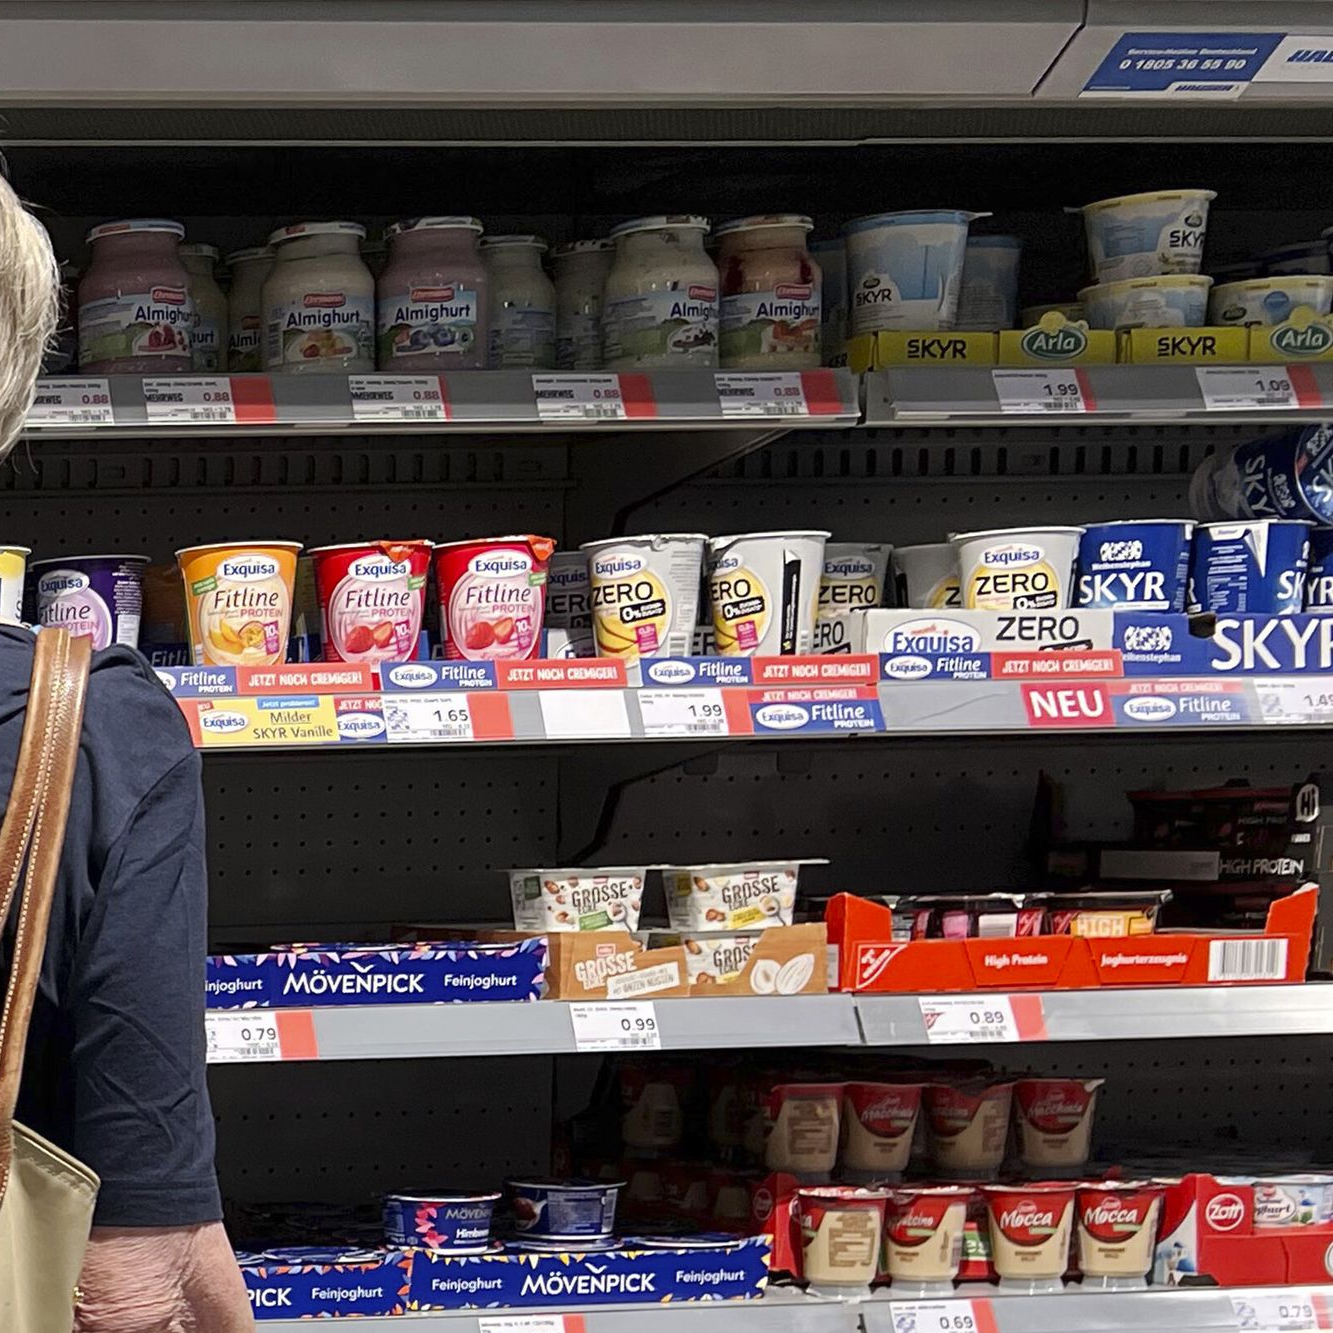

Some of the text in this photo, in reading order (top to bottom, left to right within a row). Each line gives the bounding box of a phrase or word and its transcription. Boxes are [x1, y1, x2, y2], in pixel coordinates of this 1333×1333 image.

[1119, 59, 1129, 70] 0
[1135, 59, 1174, 70] 1805
[286, 310, 362, 328] Almighurt
[906, 338, 968, 359] SKYR
[1032, 330, 1075, 353] Arla
[1157, 336, 1217, 357] SKYR
[1044, 384, 1077, 396] 1.99
[1255, 380, 1290, 392] 1.09
[984, 548, 1040, 564] Exquisa
[223, 561, 276, 577] Exquisa
[595, 557, 642, 575] Exquisa
[976, 569, 1050, 595] ZERO
[1078, 571, 1166, 605] SKYR
[213, 590, 279, 609] Fitline
[344, 589, 411, 608] Fitline
[591, 581, 654, 606] ZERO
[996, 616, 1079, 642] ZERO
[180, 671, 226, 685] Fitline
[248, 672, 363, 686] JETZT NOCH CREMIGER!
[687, 705, 722, 718] 1.99
[1025, 690, 1105, 719] NEU
[269, 711, 311, 724] Milder
[433, 709, 469, 723] 1.65
[252, 725, 333, 739] SKYR Vanille
[571, 880, 630, 907] GROSSE
[984, 953, 1010, 967] High
[283, 970, 425, 996] MÖVENPICK
[443, 972, 518, 989] Feinjoghurt
[621, 1018, 656, 1031] 0.99
[969, 1011, 1004, 1025] 0.89
[241, 1027, 276, 1041] 0.79
[1001, 1208, 1053, 1228] Mocca
[1209, 1202, 1243, 1223] Zott
[431, 1275, 502, 1293] Feinjoghurt
[521, 1262, 656, 1294] MÖVENPICK
[939, 1316, 974, 1331] 0.69
